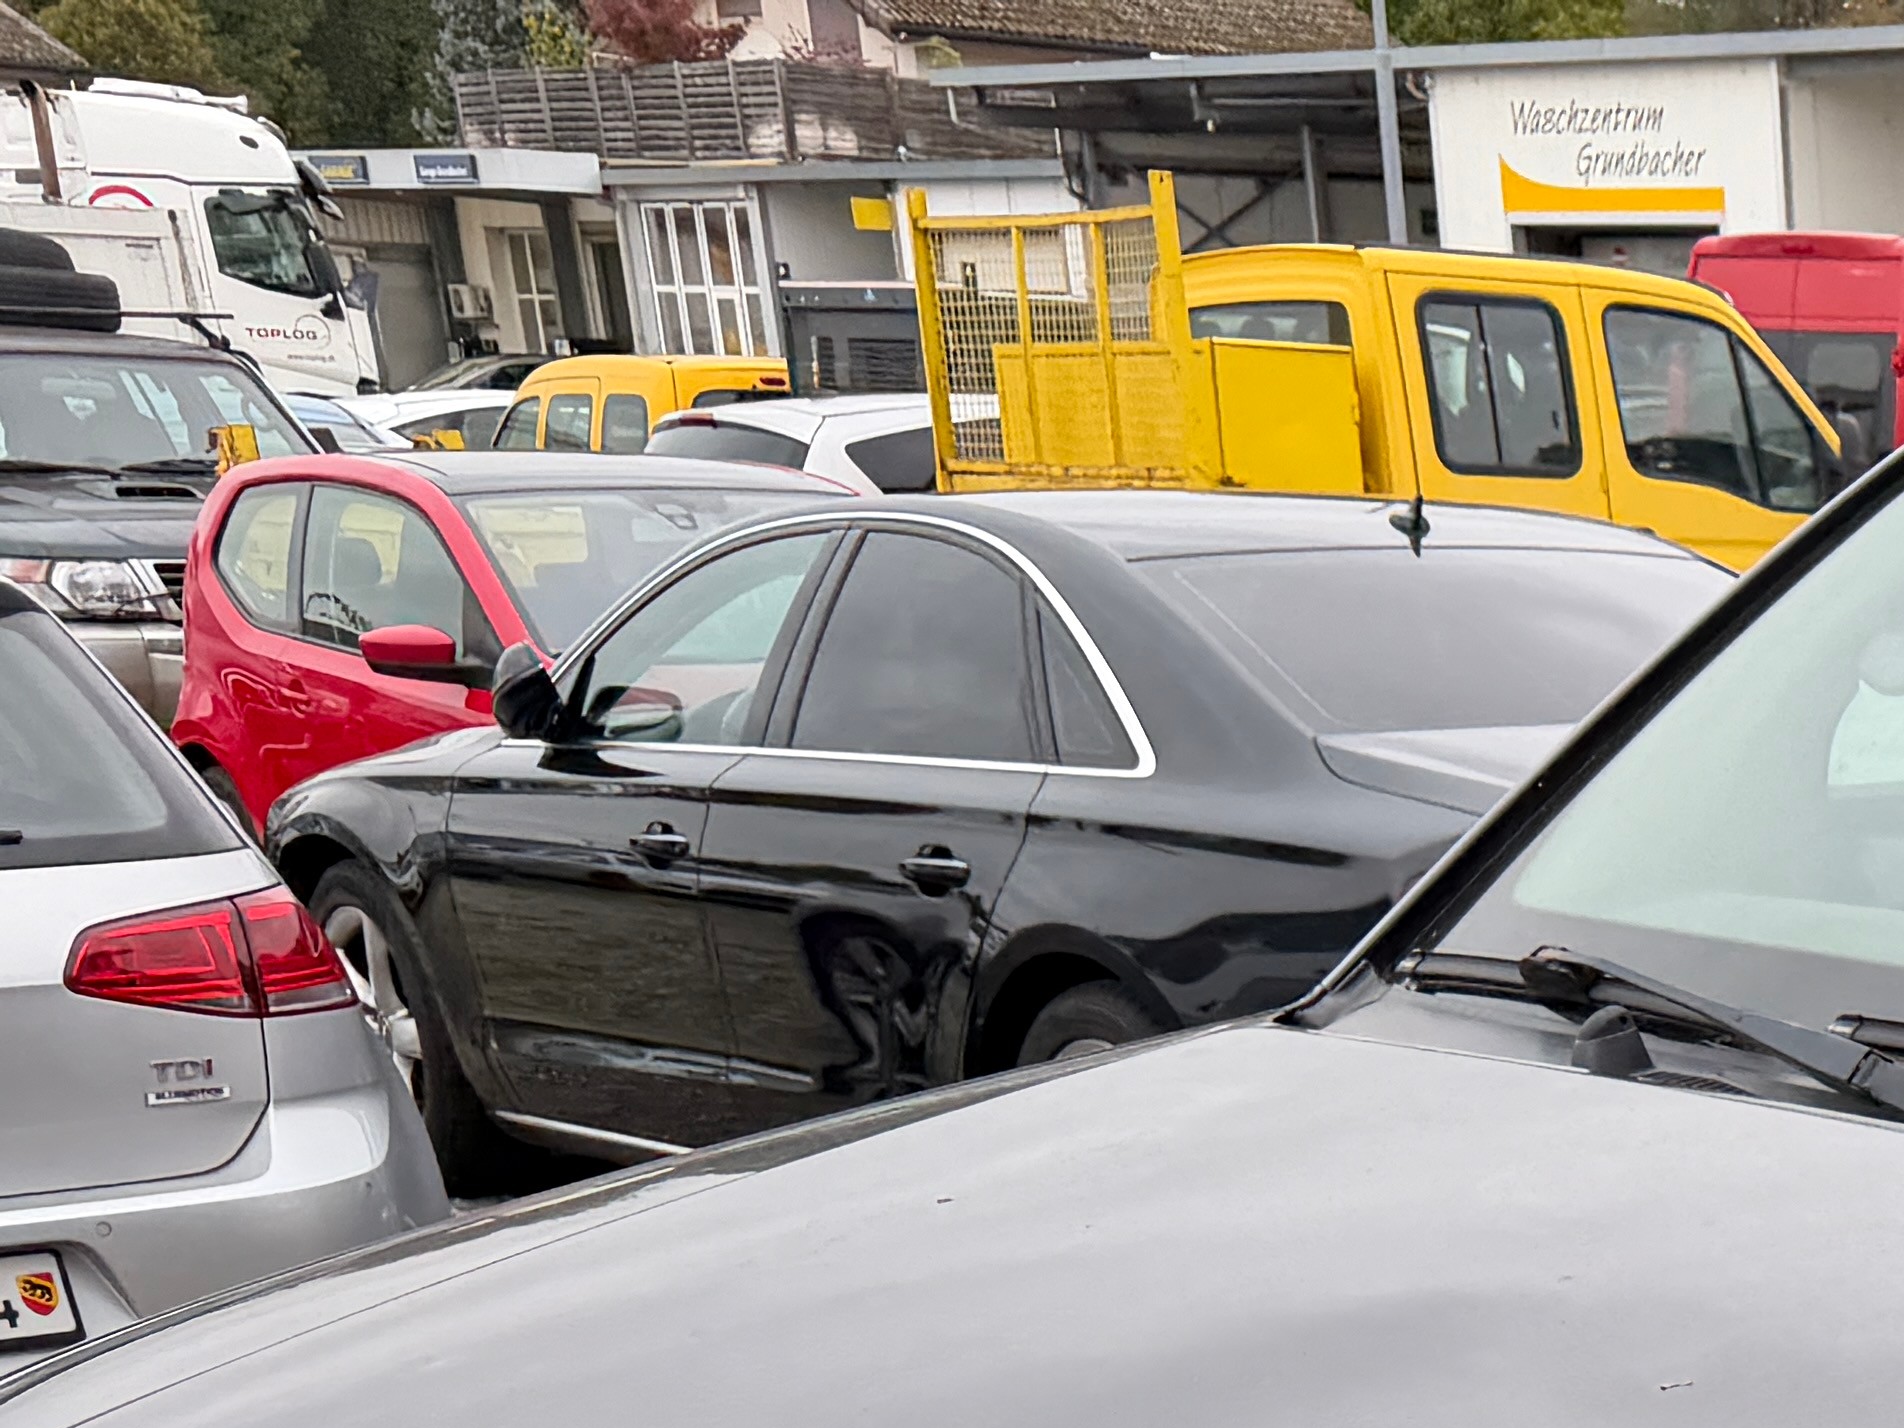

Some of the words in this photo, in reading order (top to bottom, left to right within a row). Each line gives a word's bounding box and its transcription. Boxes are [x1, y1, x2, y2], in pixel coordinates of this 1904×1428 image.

[1510, 99, 1664, 136] Waschzentrum
[1575, 136, 1706, 187] Grundbacher
[245, 327, 318, 340] TOPLOG
[149, 1058, 214, 1083] TDI
